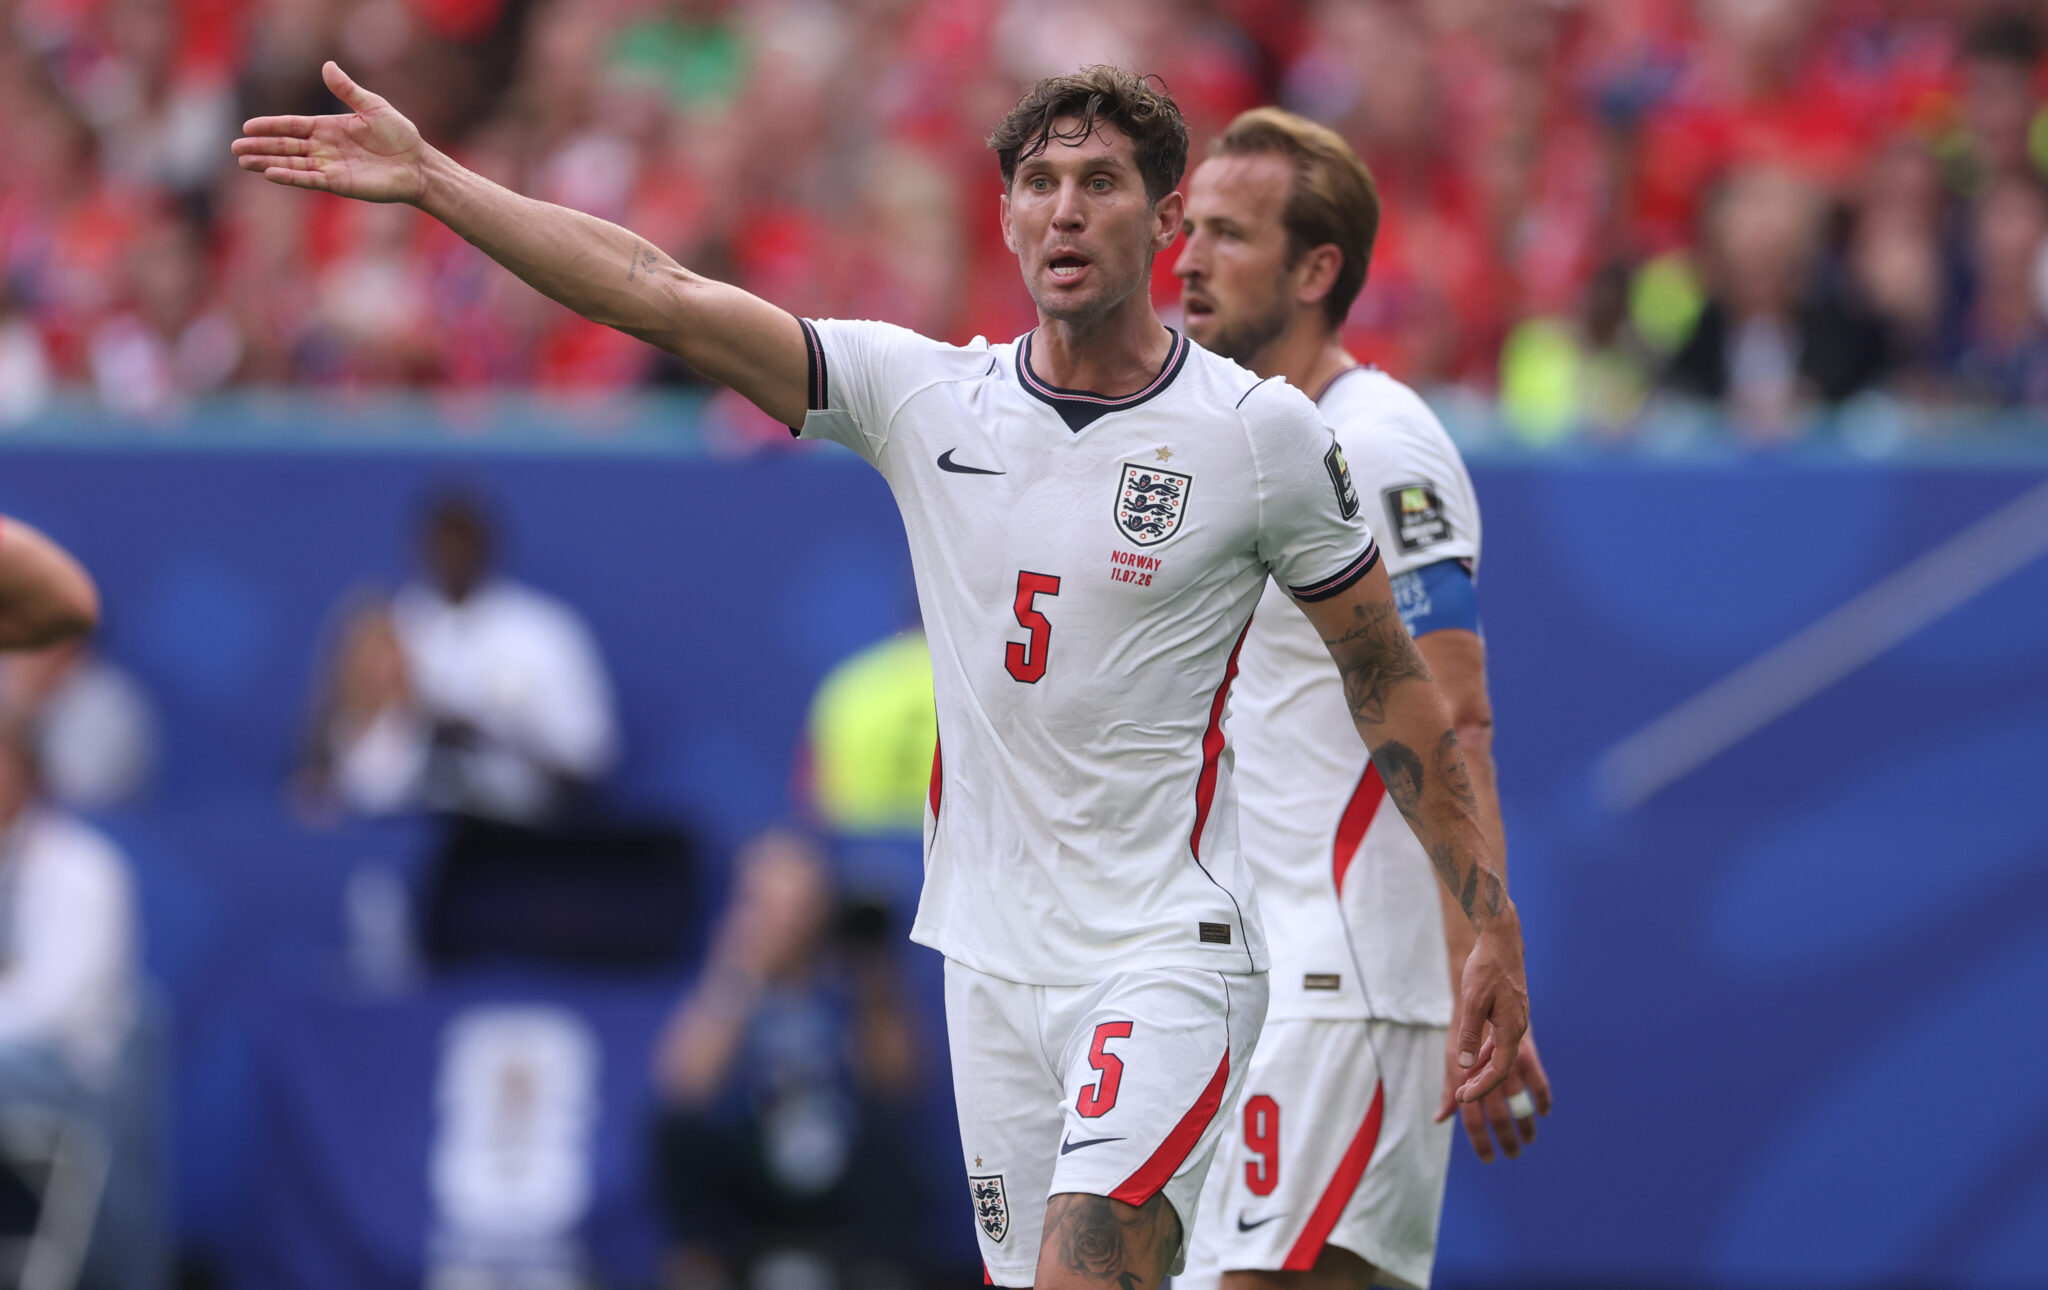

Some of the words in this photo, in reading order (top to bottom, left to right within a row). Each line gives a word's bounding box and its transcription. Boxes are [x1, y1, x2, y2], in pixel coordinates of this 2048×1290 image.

[1111, 550, 1162, 572] NORWAY
[1111, 567, 1152, 587] 11.07.26
[1004, 569, 1061, 685] 5
[1076, 1021, 1134, 1119] 5
[1243, 1094, 1280, 1198] 9
